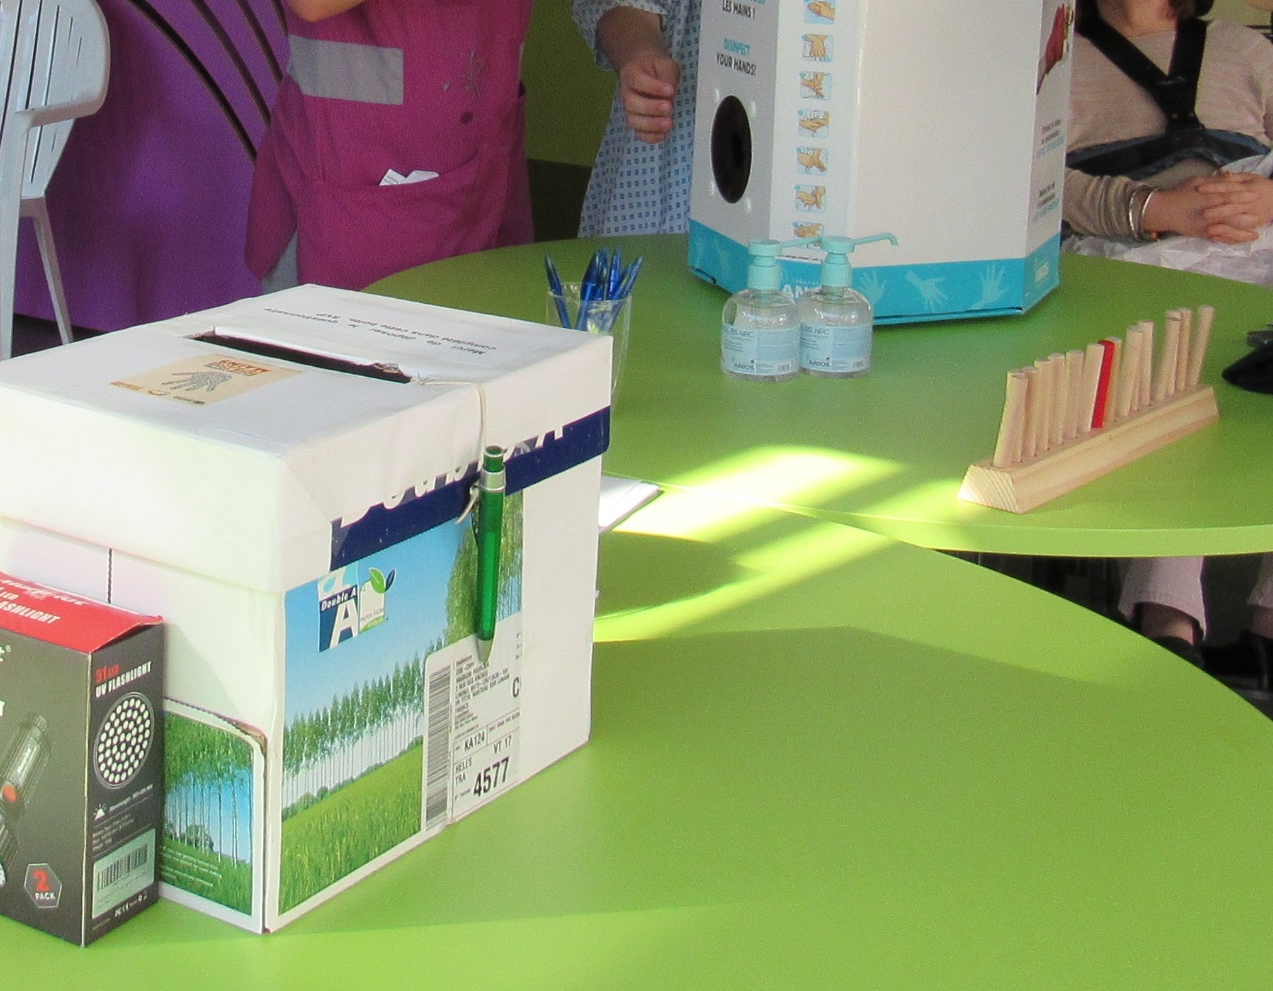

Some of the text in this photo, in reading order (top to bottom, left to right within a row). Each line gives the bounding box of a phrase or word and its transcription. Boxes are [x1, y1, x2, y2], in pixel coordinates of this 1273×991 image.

[716, 52, 733, 68] YOUR
[321, 586, 357, 611] Double A
[95, 666, 107, 684] 51
[95, 660, 152, 698] UV FLASHLIGHT
[464, 730, 486, 753] KA124
[504, 734, 513, 749] 17
[472, 755, 510, 798] 4577
[33, 869, 52, 892] 2
[34, 892, 56, 901] PACK
